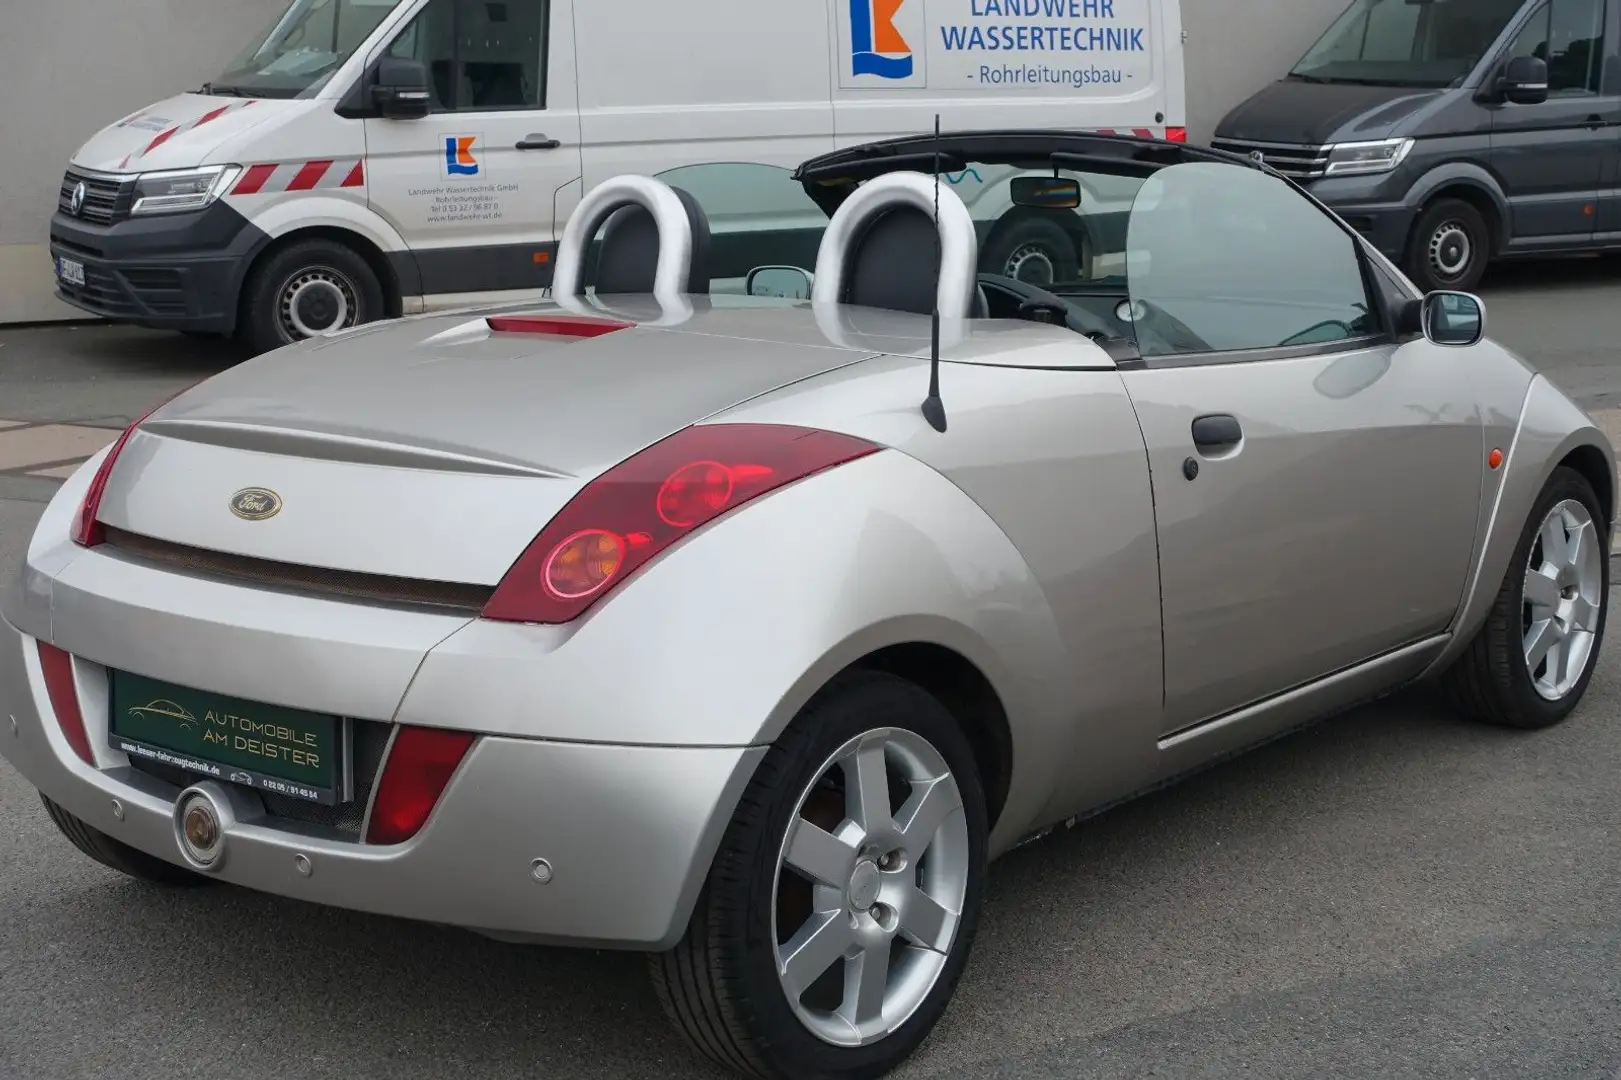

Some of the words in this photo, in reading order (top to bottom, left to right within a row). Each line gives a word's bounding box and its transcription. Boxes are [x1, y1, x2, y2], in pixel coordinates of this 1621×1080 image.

[970, 0, 1115, 18] LANDWEHR
[940, 26, 1145, 51] WASSERTECHNIK
[980, 65, 1122, 88] Rohrleitungsbau
[408, 187, 444, 196] Landwehr
[446, 185, 495, 194] Wassertechnik
[496, 183, 519, 192] GmbH
[204, 709, 318, 747] AUTOMOBILE
[203, 728, 228, 746] AM
[234, 736, 320, 768] DEISTER
